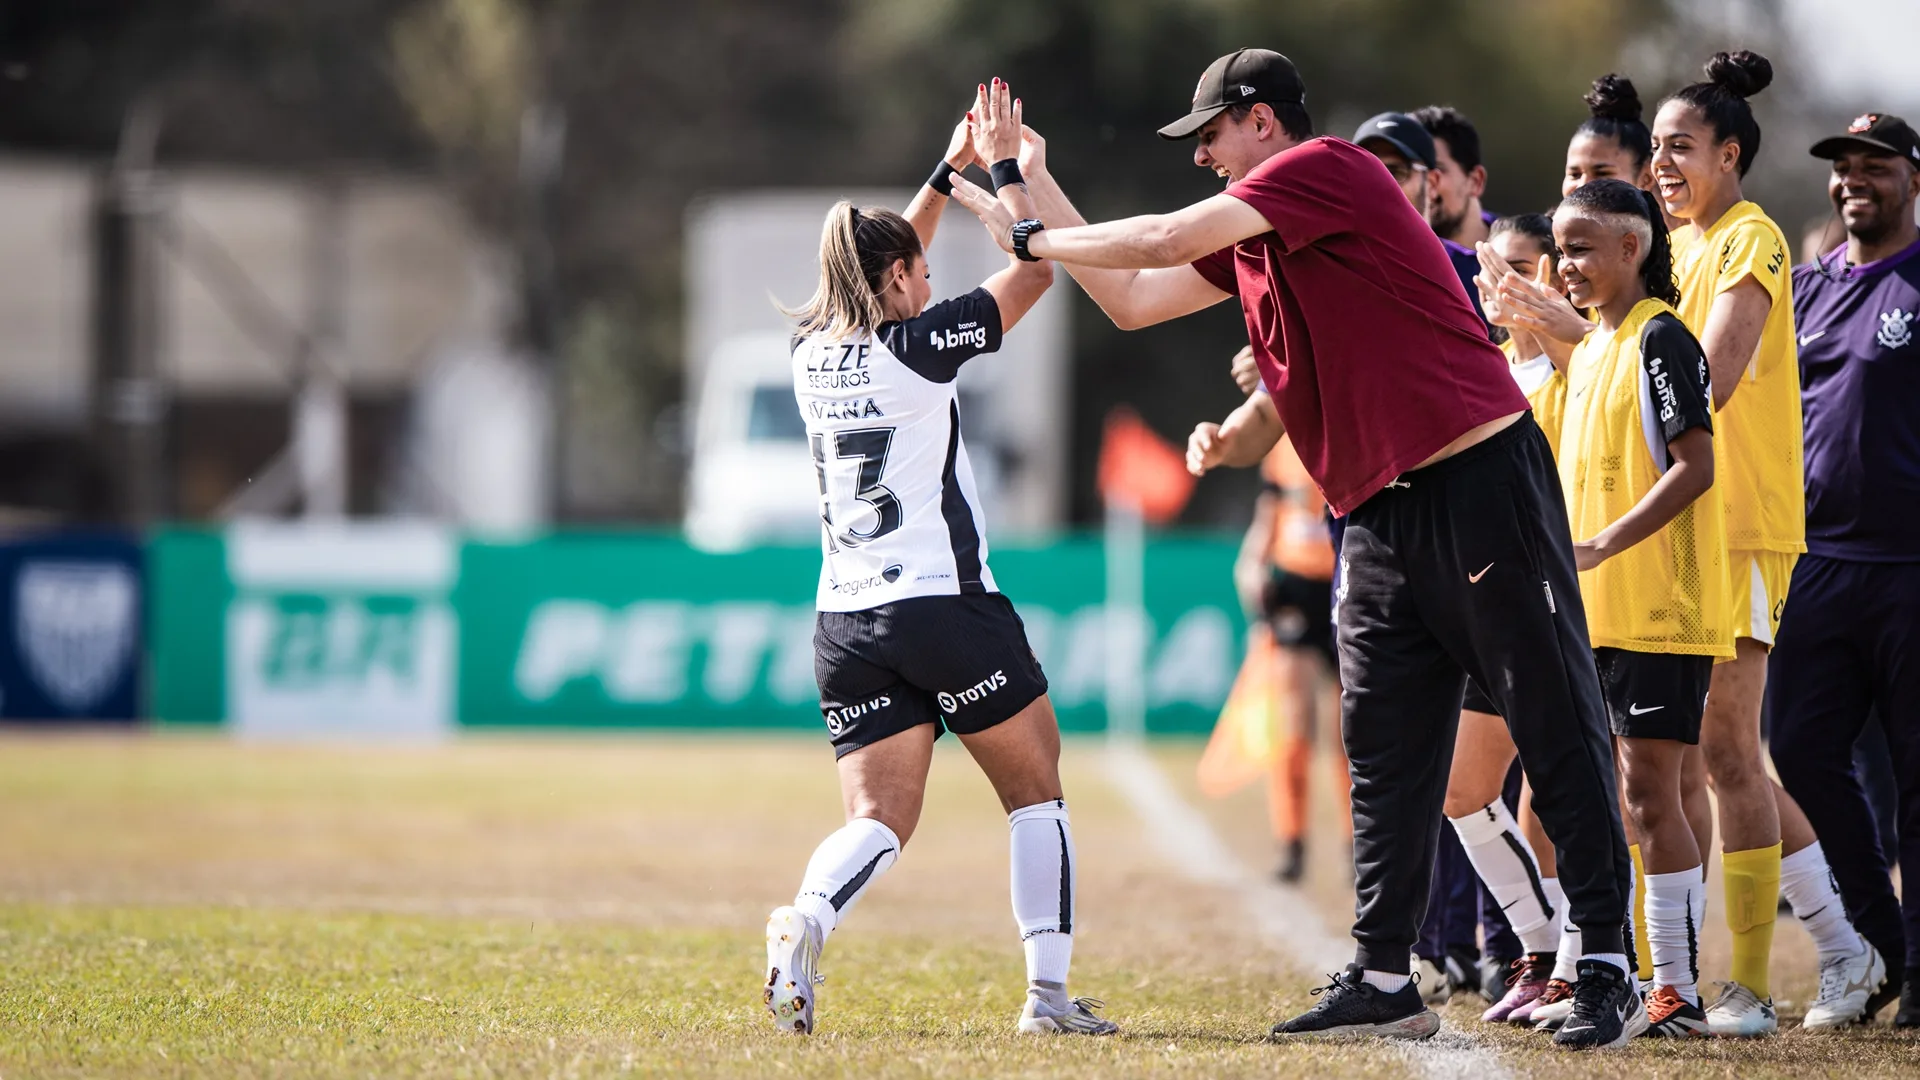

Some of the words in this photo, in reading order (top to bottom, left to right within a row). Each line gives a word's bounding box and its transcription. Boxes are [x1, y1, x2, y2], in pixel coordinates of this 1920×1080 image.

[944, 326, 987, 349] bmg
[957, 321, 978, 330] banco
[808, 371, 871, 389] SEGUROS
[1653, 371, 1675, 423] bmg
[811, 426, 904, 556] 13
[956, 669, 1008, 706] TOTVS
